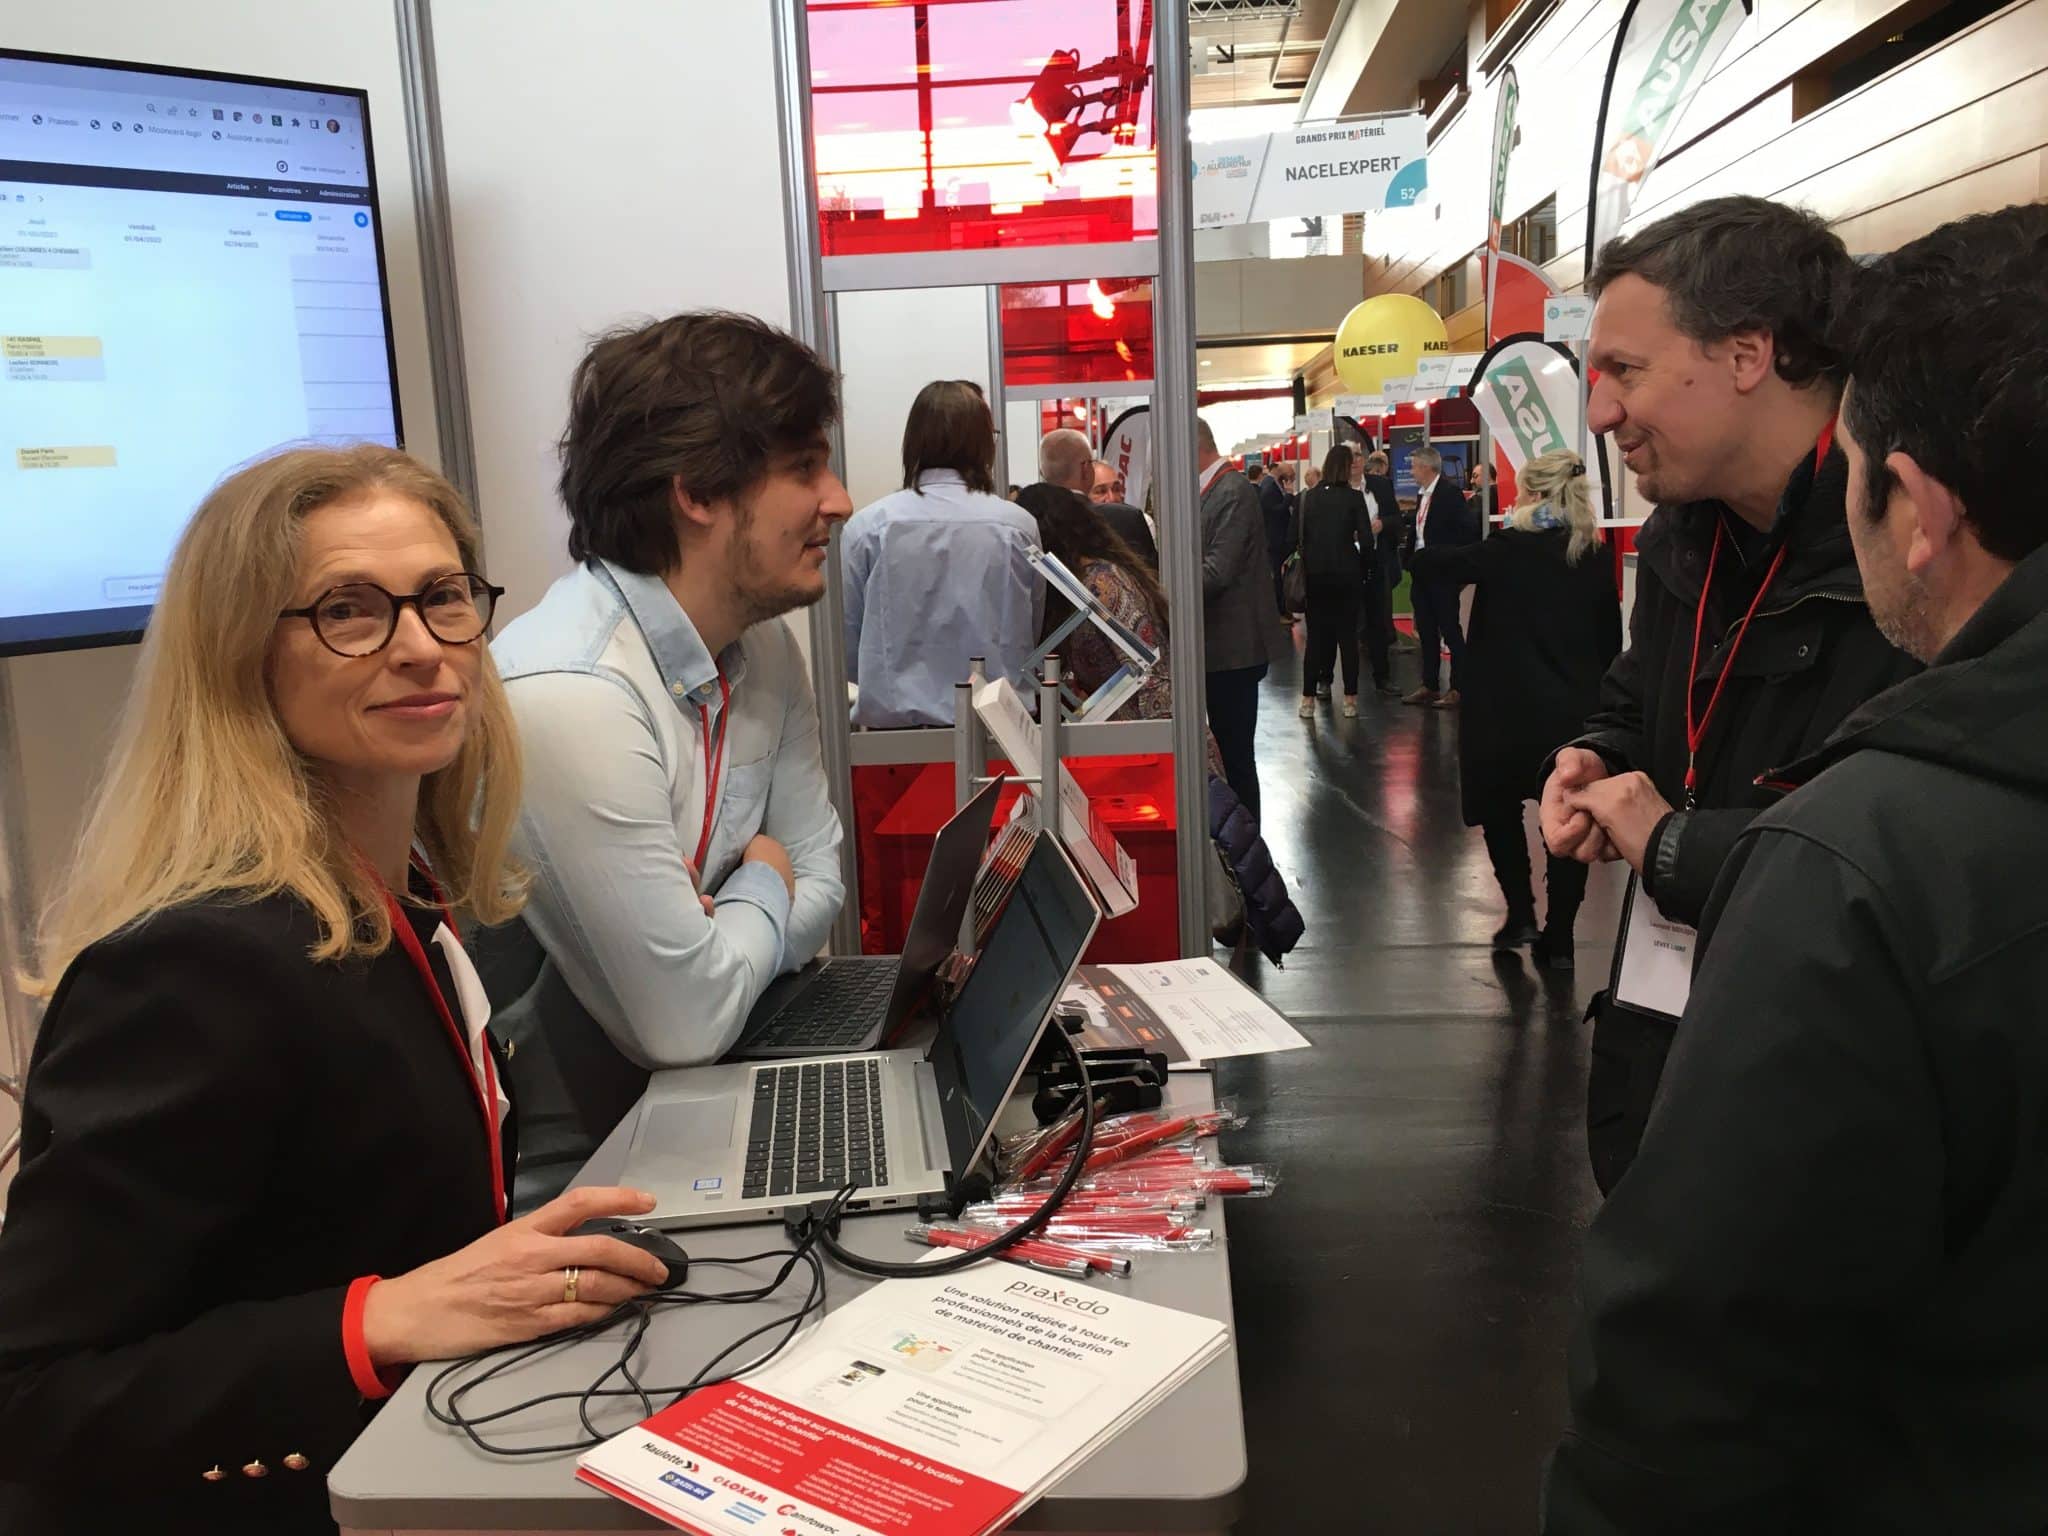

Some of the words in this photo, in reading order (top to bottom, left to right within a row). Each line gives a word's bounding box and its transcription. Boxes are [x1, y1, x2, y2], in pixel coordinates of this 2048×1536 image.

[1295, 132, 1327, 145] GRANDS
[1328, 130, 1347, 142] PRIX
[1348, 126, 1385, 142] MATÉRIEL
[1286, 156, 1400, 182] NACELEXPERT
[1401, 188, 1416, 200] 52
[1343, 343, 1399, 358] KAESER
[1004, 1280, 1109, 1316] praxedo
[931, 1295, 1024, 1330] professionnels
[1025, 1322, 1044, 1335] de
[1047, 1329, 1057, 1339] la
[1060, 1334, 1113, 1356] location
[944, 1286, 969, 1299] Une
[971, 1294, 1020, 1315] solution
[1021, 1309, 1067, 1330] dédiée
[1079, 1326, 1108, 1343] tous
[1109, 1335, 1131, 1349] les
[935, 1307, 953, 1318] de
[954, 1313, 1008, 1336] matériel
[1008, 1330, 1026, 1342] de
[1027, 1338, 1084, 1361] chantier.
[737, 1403, 773, 1424] matériel
[785, 1422, 824, 1442] chantier
[642, 1441, 684, 1466] Haulotte
[748, 1396, 779, 1416] logiciel
[825, 1428, 900, 1462] problématiques
[923, 1466, 965, 1486] location
[722, 1478, 768, 1504] LOXAM
